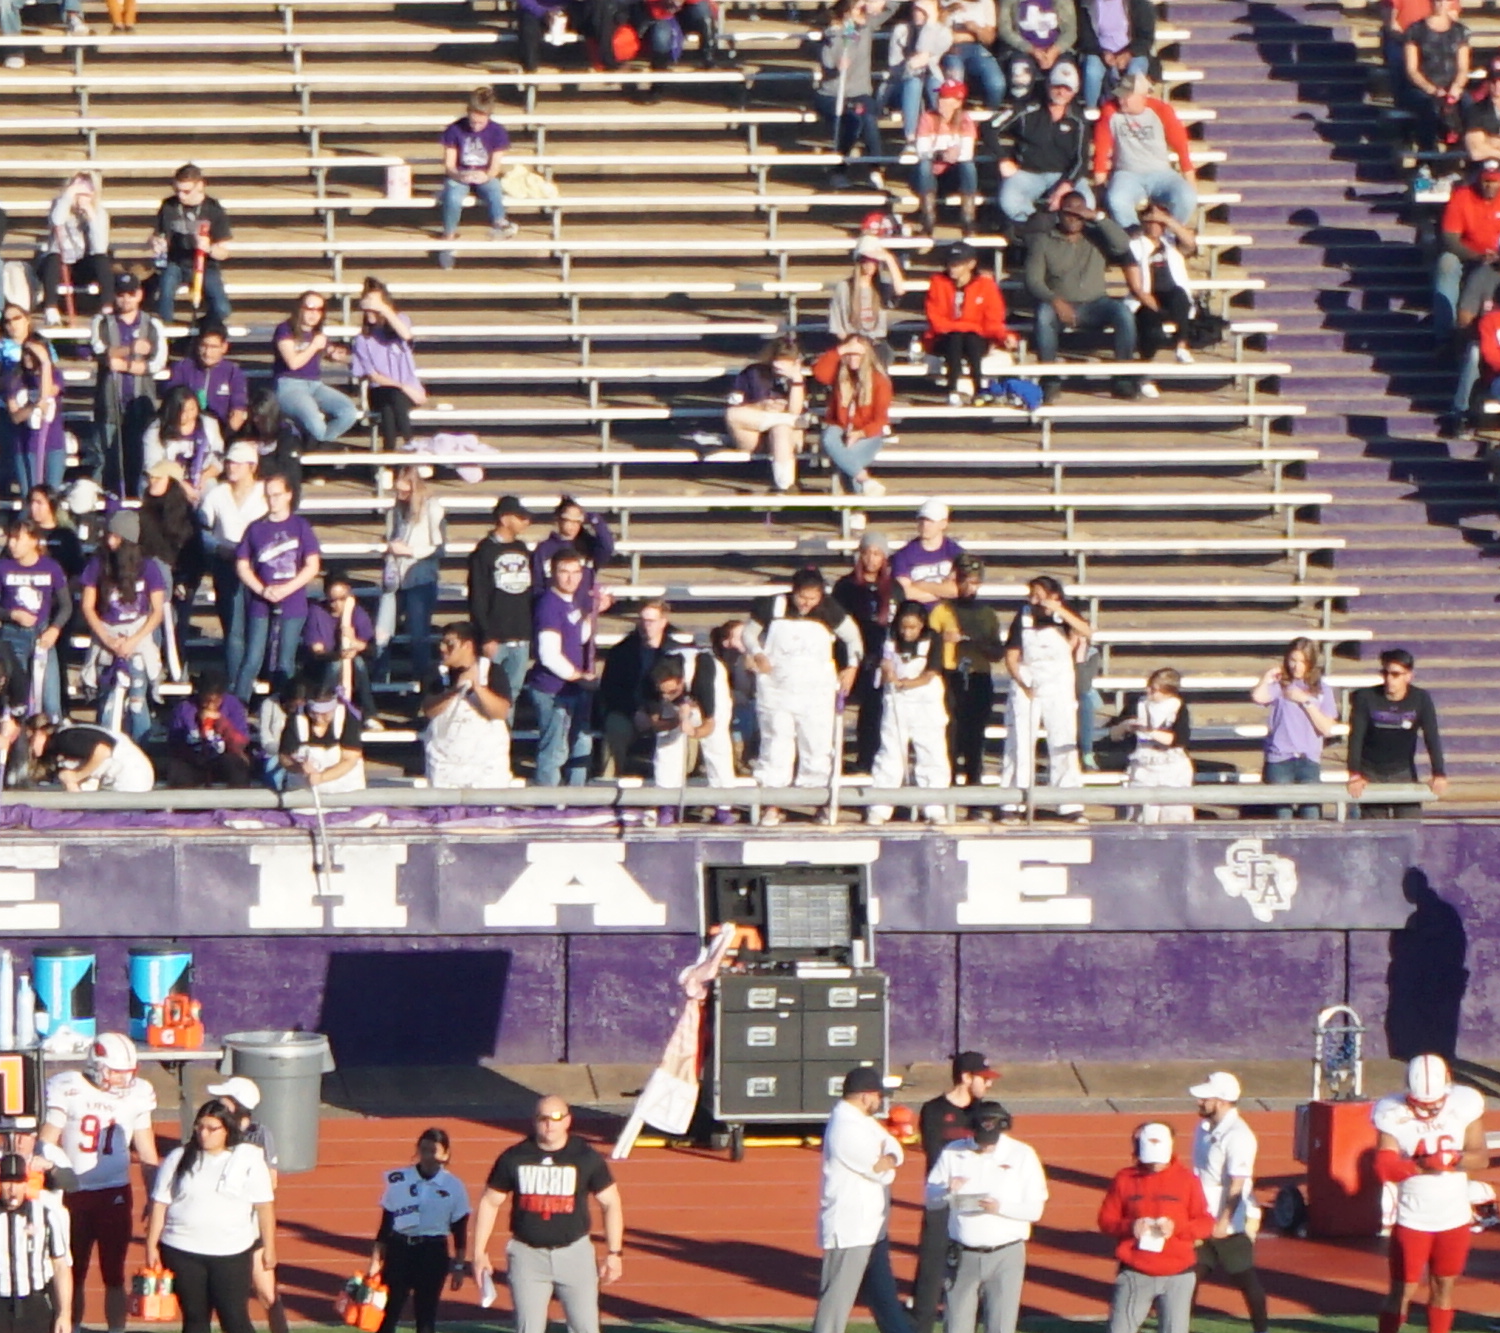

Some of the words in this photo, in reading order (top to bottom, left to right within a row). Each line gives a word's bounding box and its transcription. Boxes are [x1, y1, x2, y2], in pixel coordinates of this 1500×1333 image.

[1230, 847, 1287, 904] SFA
[79, 1115, 116, 1155] 91
[518, 1165, 577, 1195] WORD
